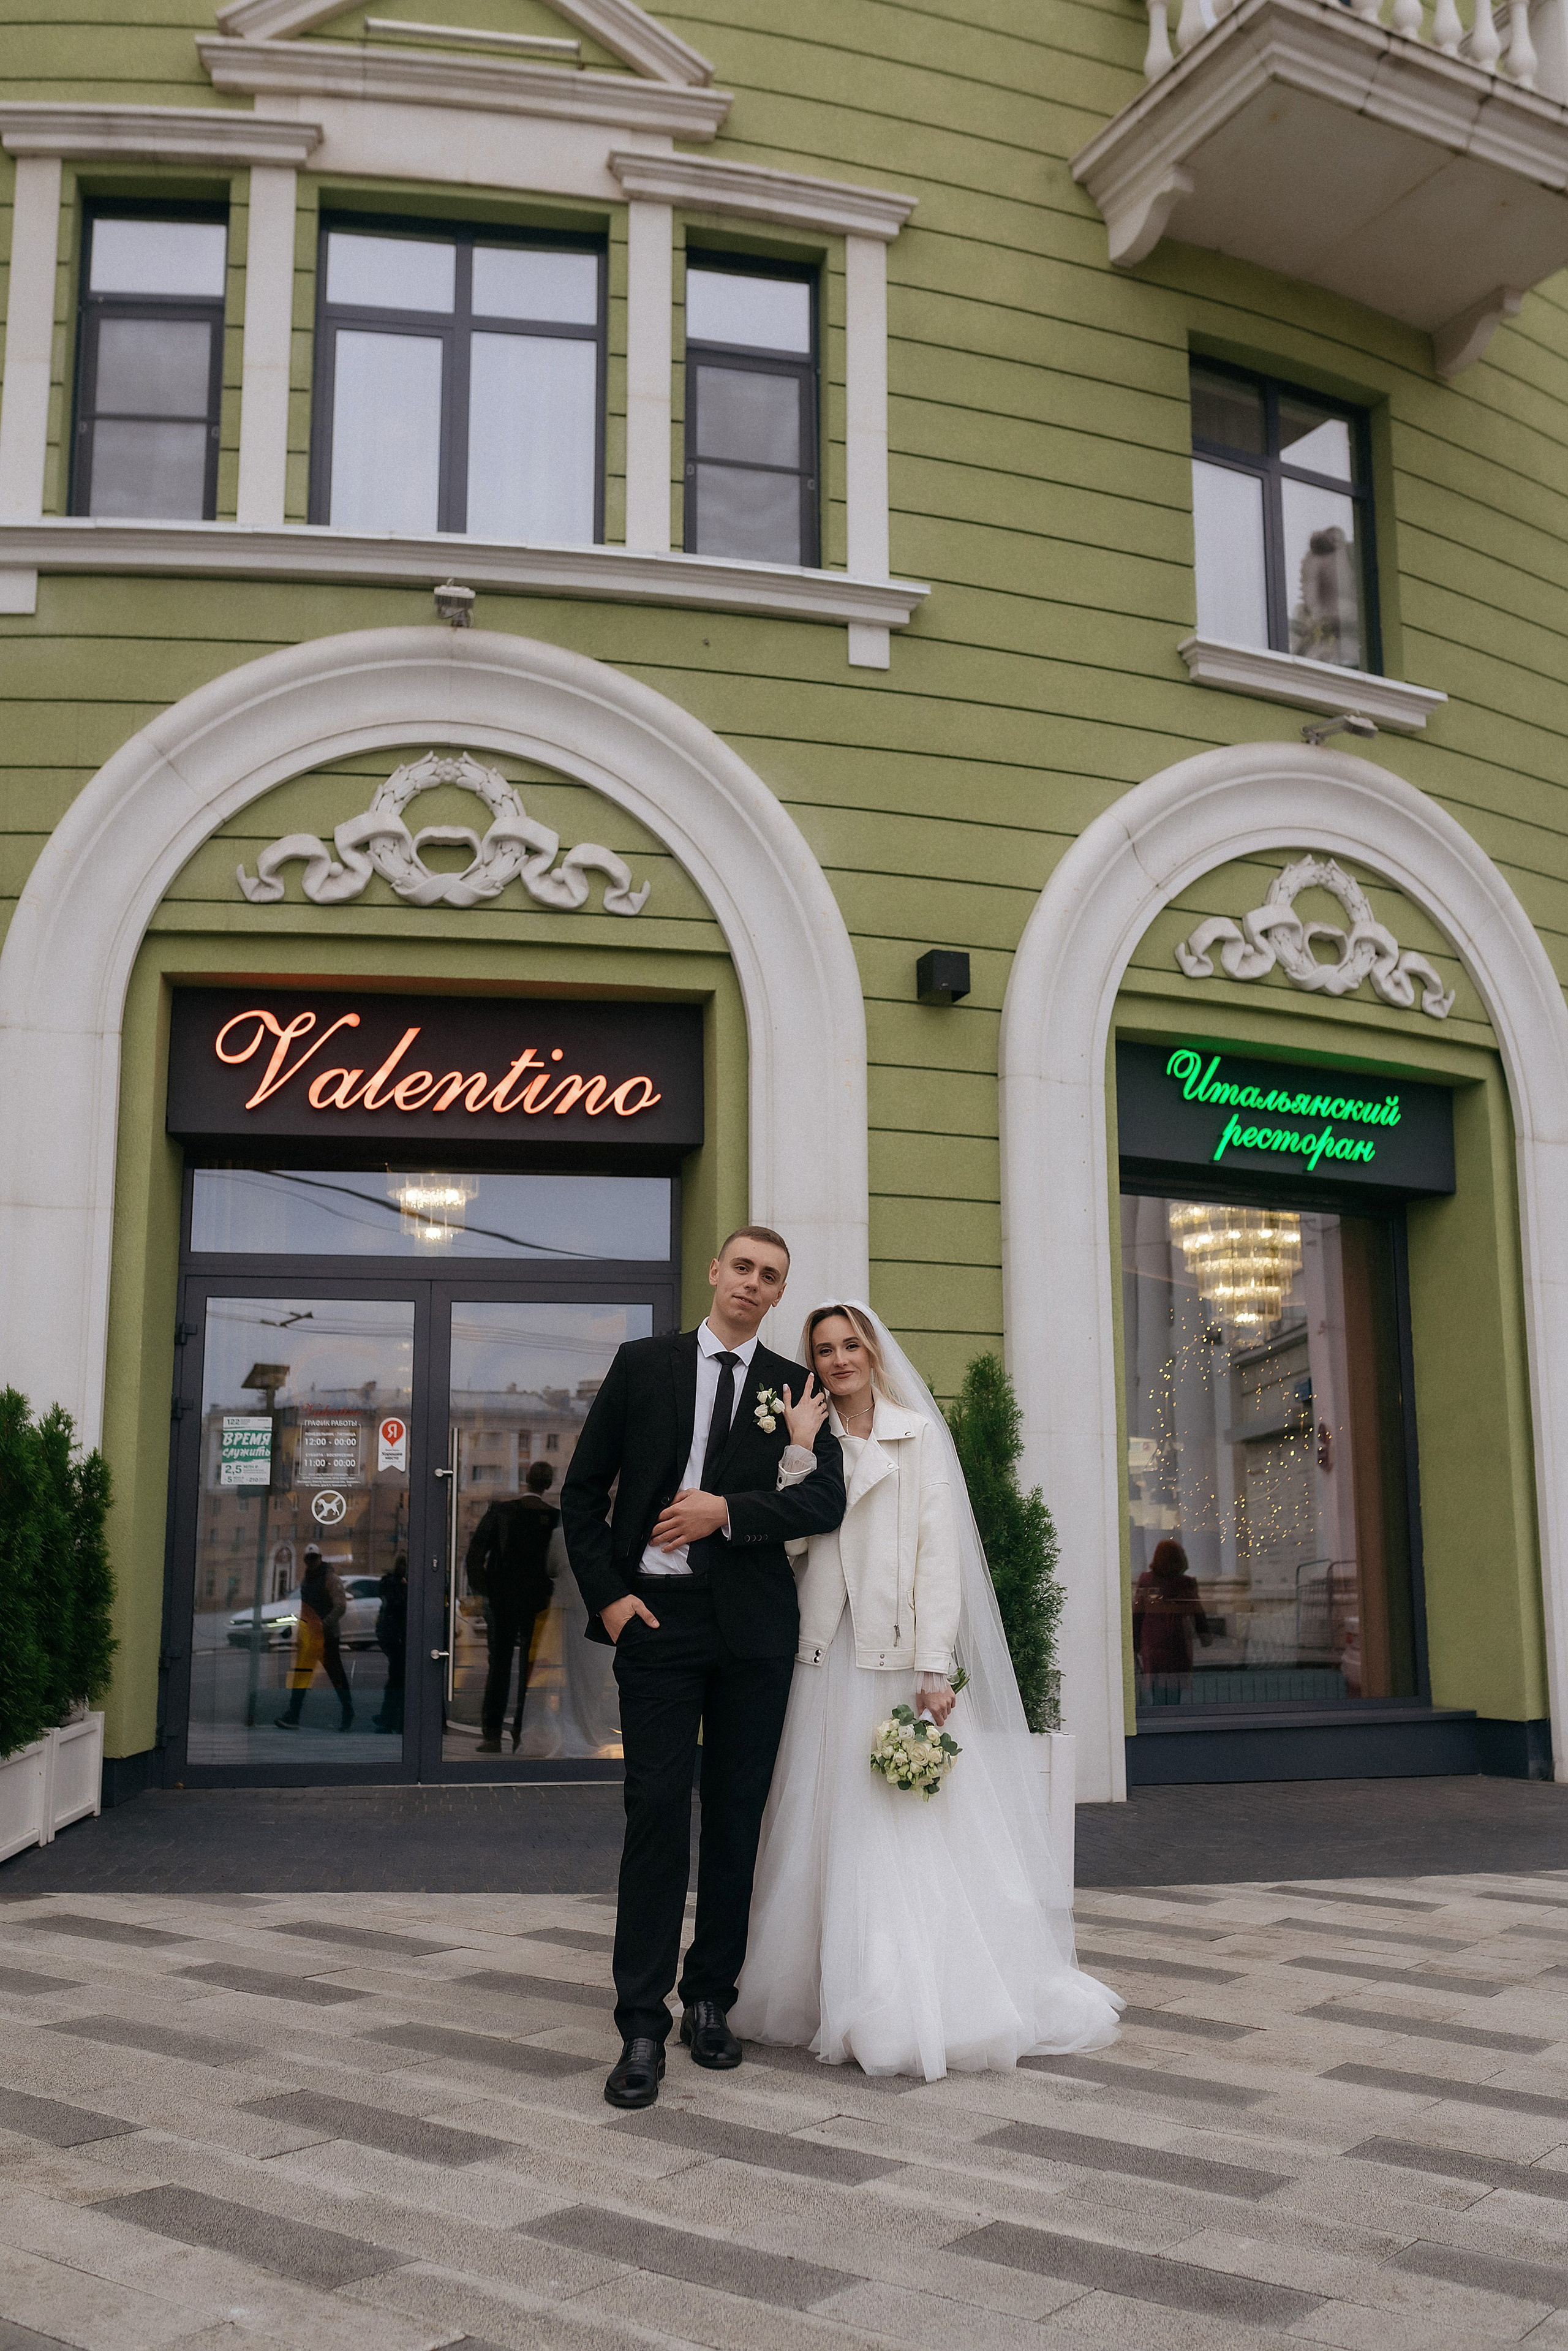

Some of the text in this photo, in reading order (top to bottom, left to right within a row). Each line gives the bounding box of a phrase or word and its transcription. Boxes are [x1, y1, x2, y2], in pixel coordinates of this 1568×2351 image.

[215, 1009, 662, 1116] Valentino
[1166, 1049, 1401, 1126] Итальянский
[1212, 1112, 1376, 1171] ресторан
[387, 1423, 398, 1438] Я
[222, 1432, 272, 1446] ВРЕМЯ
[222, 1446, 271, 1459] служить
[225, 1465, 242, 1475] 2,5
